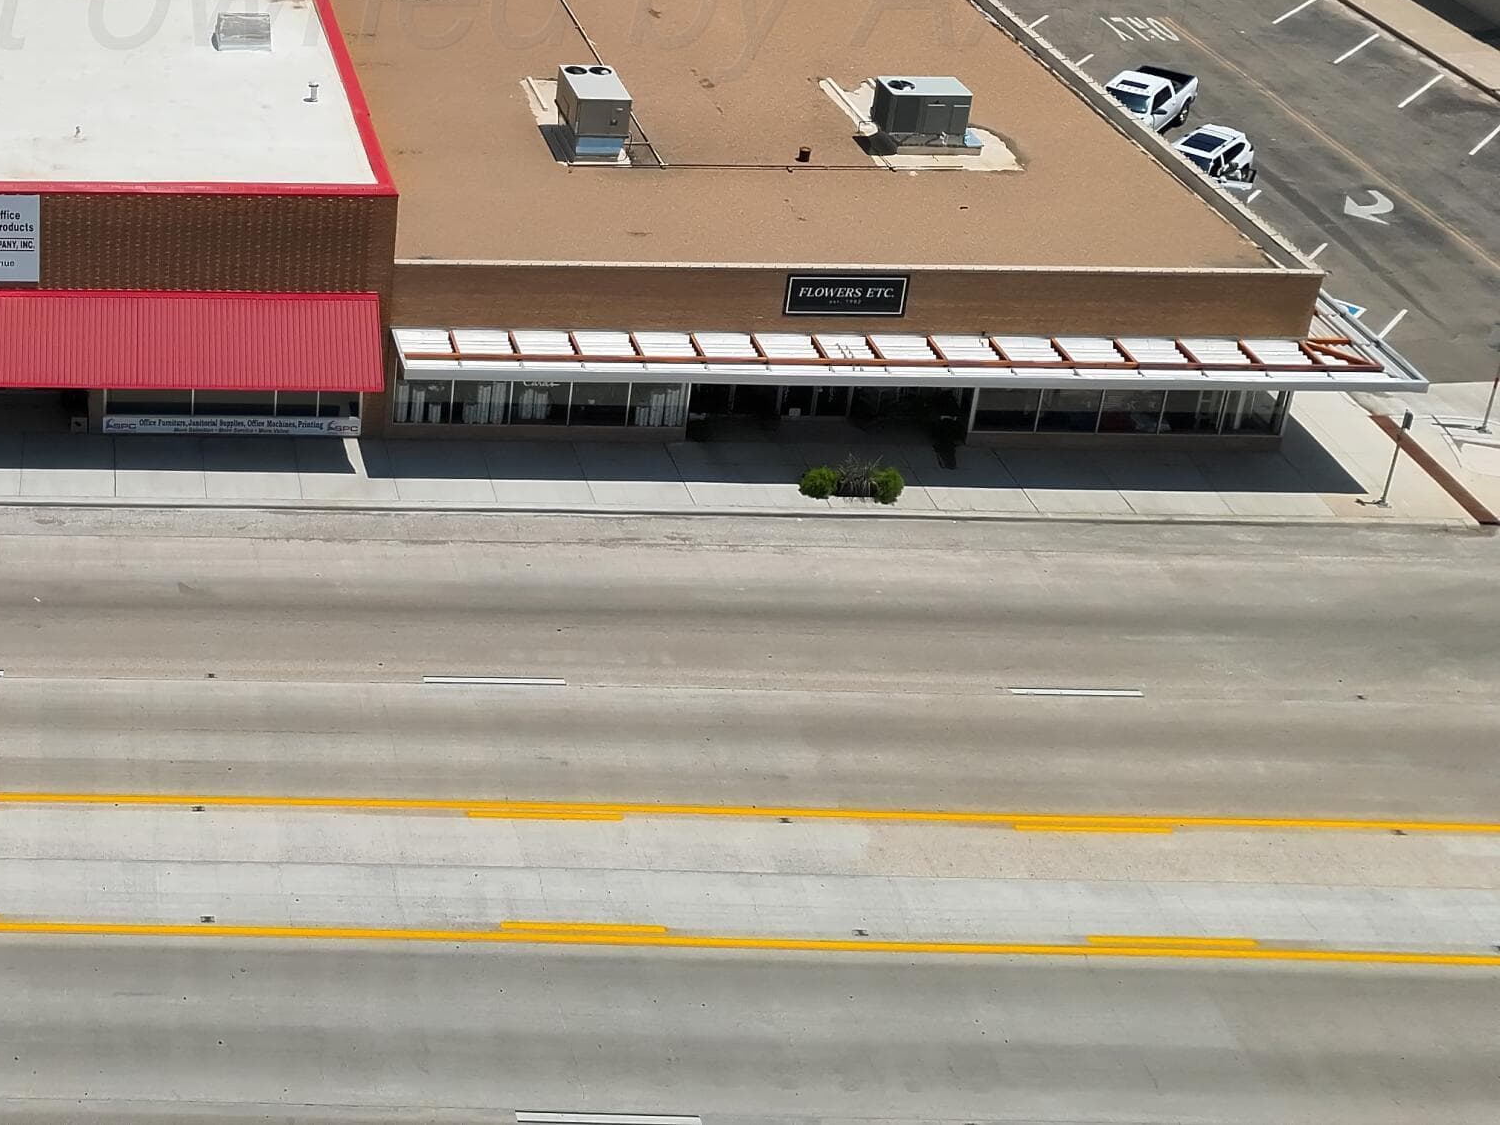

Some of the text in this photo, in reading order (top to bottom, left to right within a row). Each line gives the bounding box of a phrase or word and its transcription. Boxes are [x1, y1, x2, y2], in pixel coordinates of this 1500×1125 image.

[20, 240, 36, 250] INC.
[798, 287, 895, 298] FLOWERS ETC.
[113, 422, 137, 430] SPC
[139, 418, 157, 426] Office
[188, 418, 217, 427] Janitorial
[247, 419, 265, 427] Office
[298, 420, 323, 430] Printing
[334, 424, 359, 432] SPC
